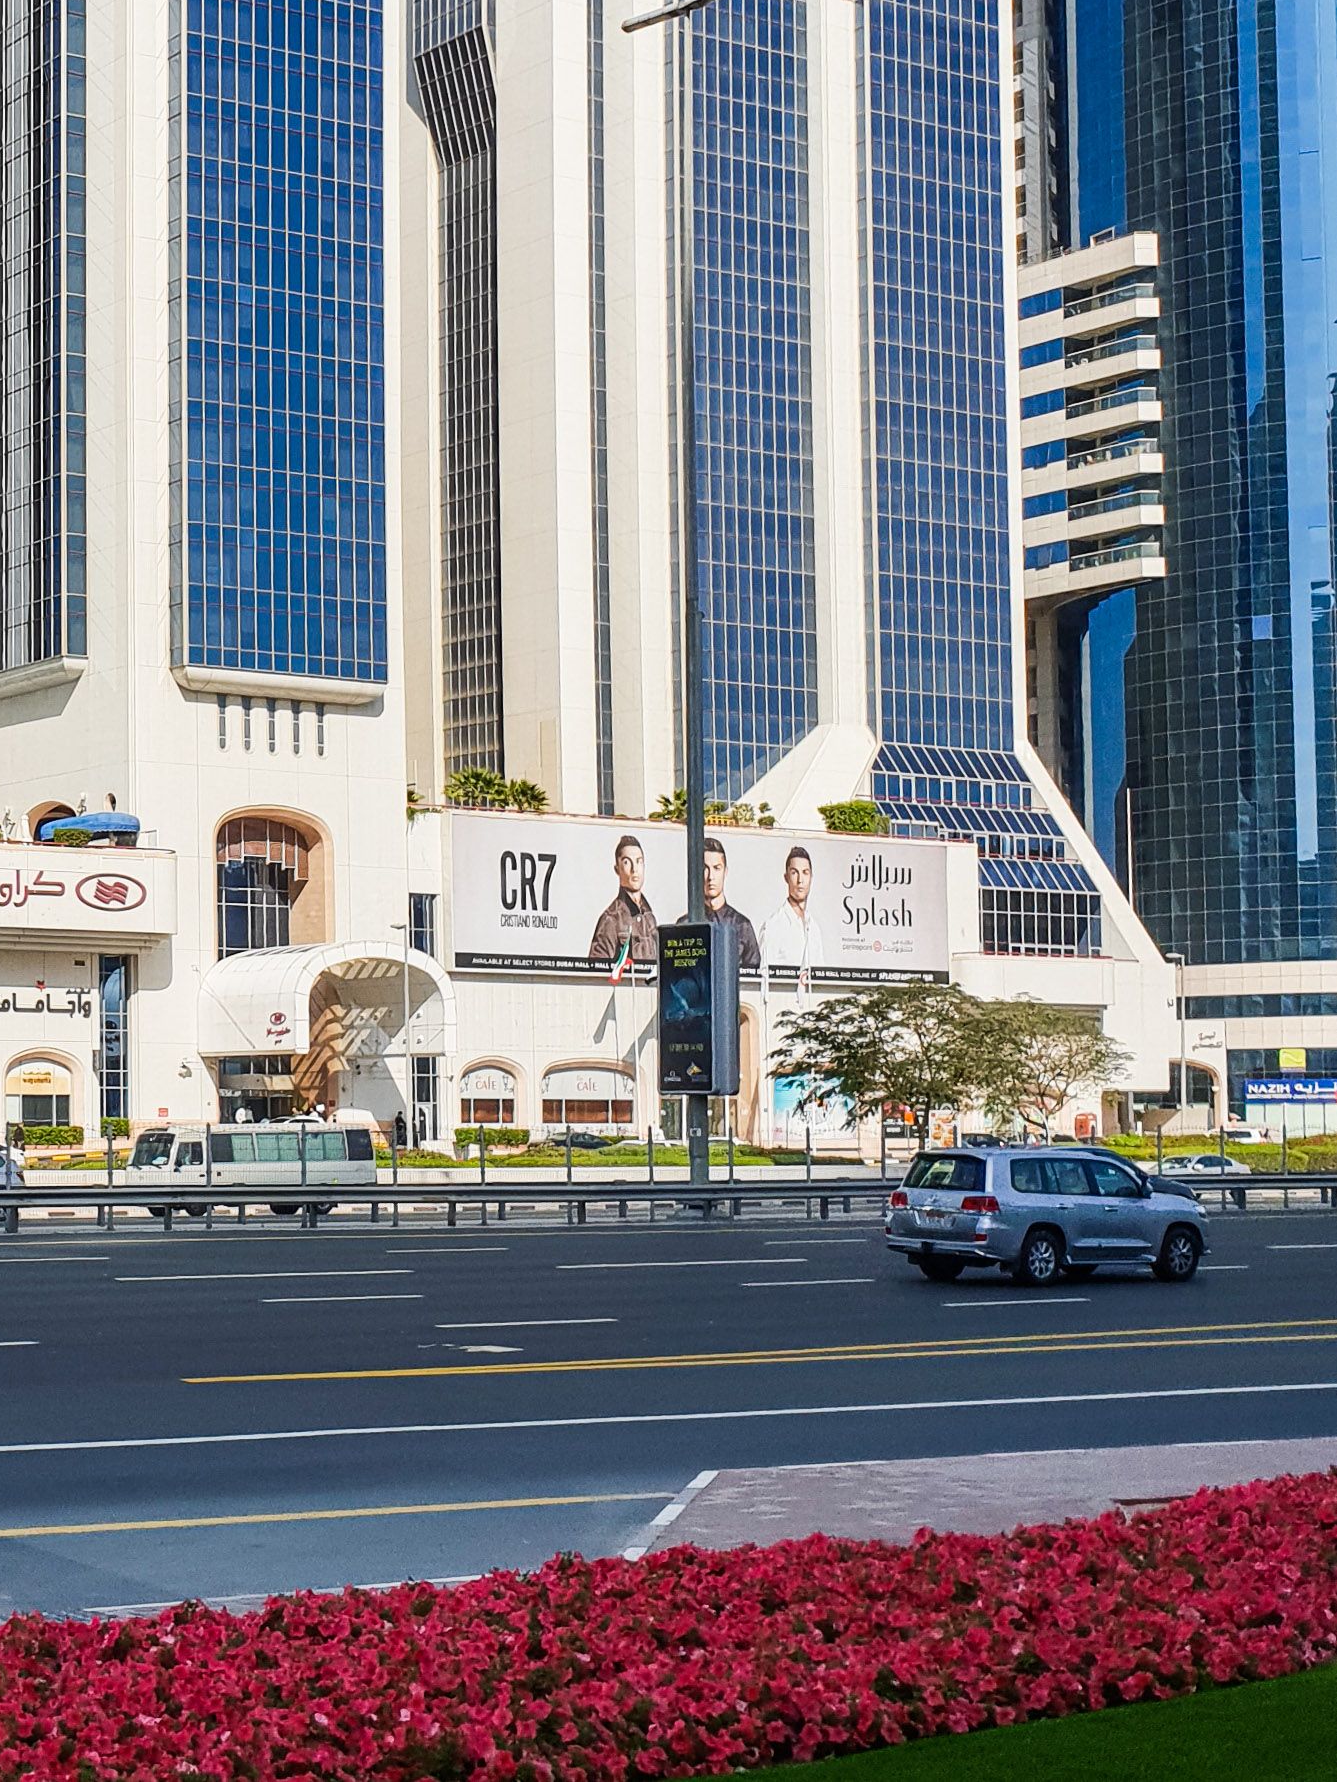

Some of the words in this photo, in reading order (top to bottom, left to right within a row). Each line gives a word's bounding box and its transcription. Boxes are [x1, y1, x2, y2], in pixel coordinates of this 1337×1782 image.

[500, 850, 557, 912] CR7
[842, 895, 912, 935] Splash
[1247, 1083, 1290, 1094] NAZIH
